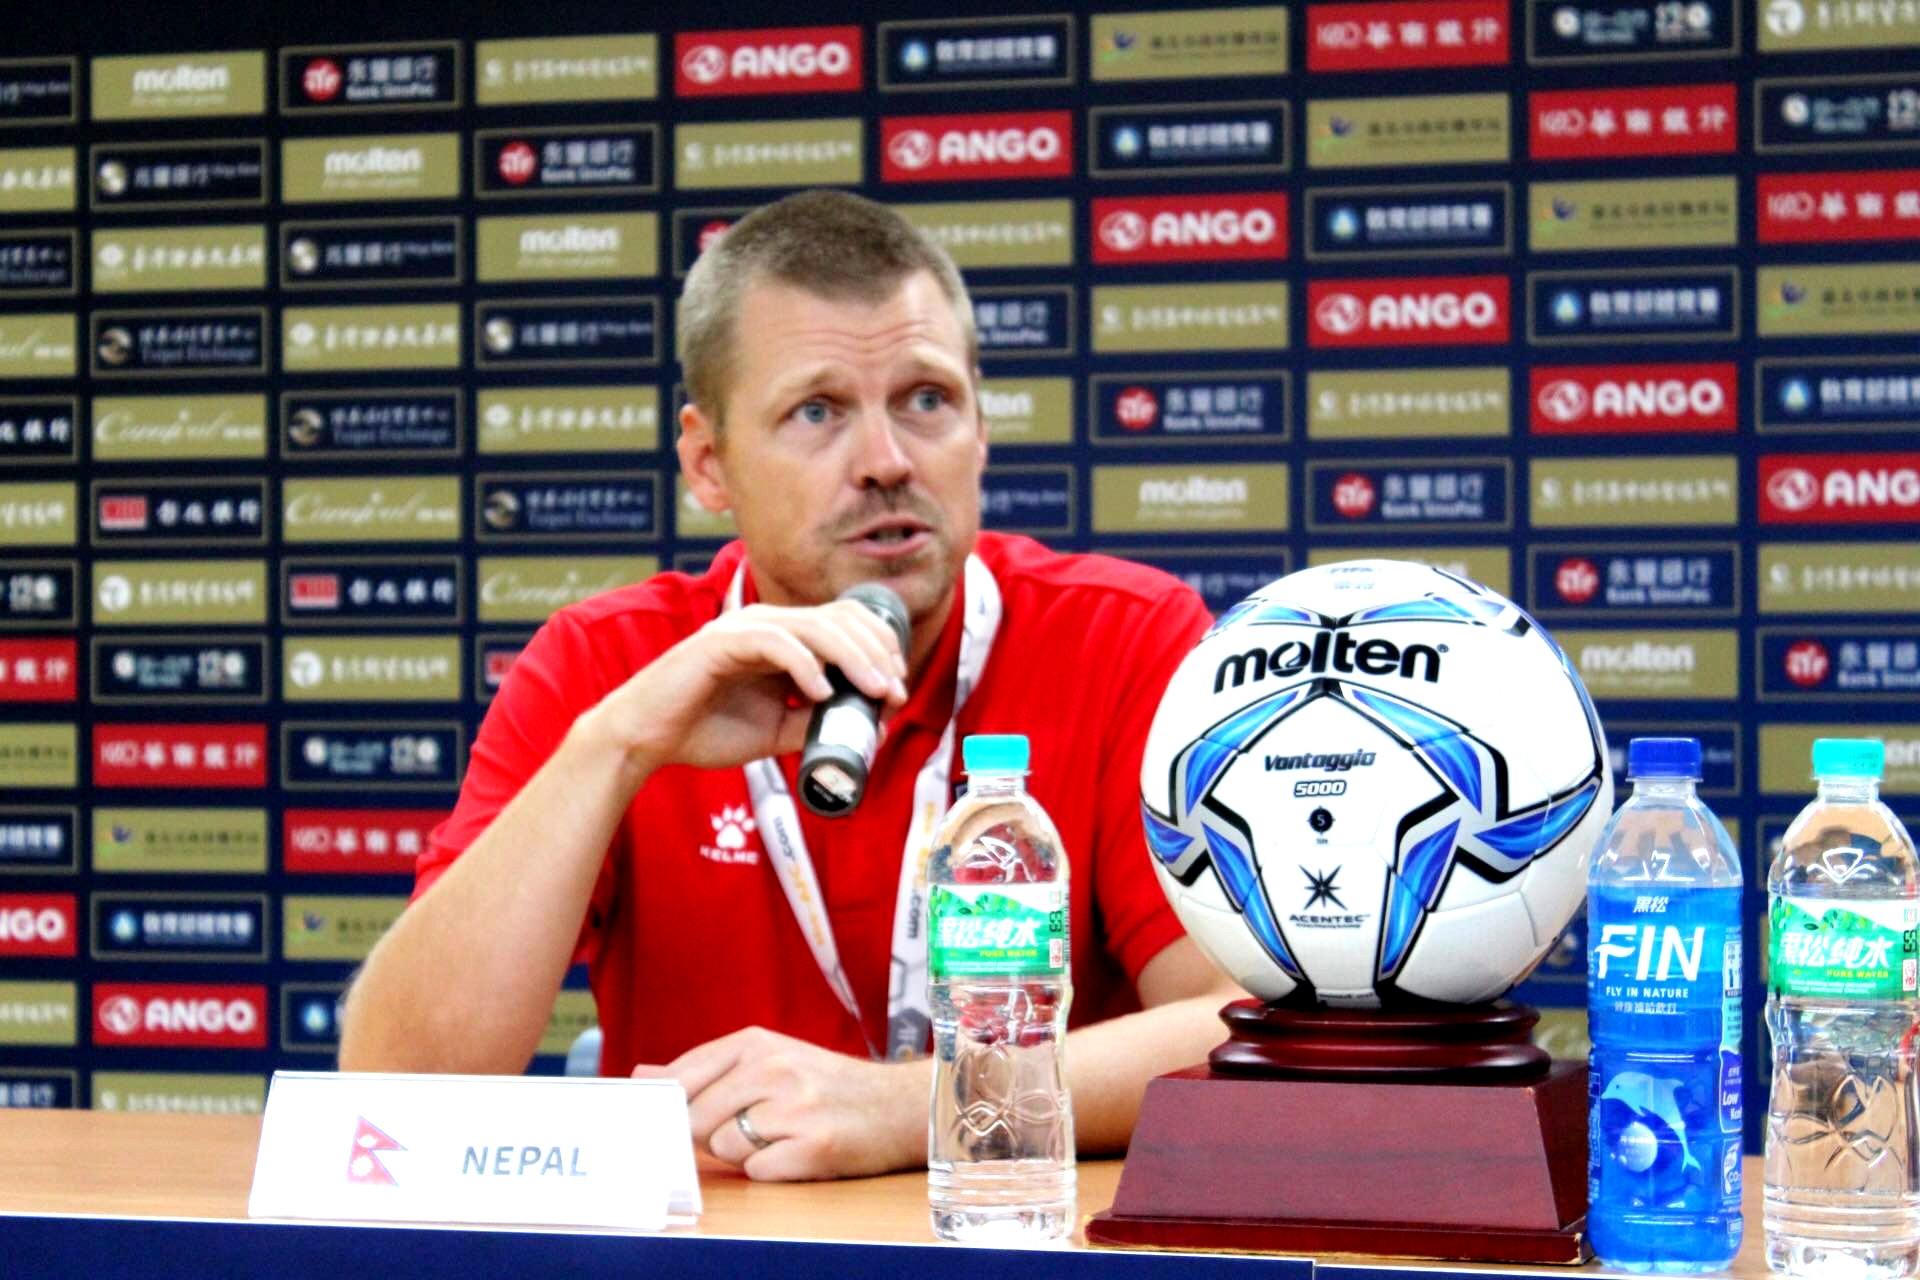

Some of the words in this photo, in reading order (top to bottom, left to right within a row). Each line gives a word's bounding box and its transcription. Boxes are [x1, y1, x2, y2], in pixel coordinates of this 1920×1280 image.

[731, 43, 850, 77] ANGO
[134, 65, 228, 91] molten
[325, 148, 422, 174] molten
[932, 128, 1060, 162] ANGO
[520, 226, 619, 252] molten
[1151, 209, 1275, 244] ANGO
[1369, 293, 1496, 328] ANGO
[1593, 380, 1723, 415] ANGO
[1140, 476, 1247, 504] molten
[1214, 630, 1441, 694] molten
[1580, 643, 1694, 674] molten
[1264, 748, 1376, 772] Vantaggio
[1294, 780, 1347, 798] 5000
[1593, 924, 1706, 982] FIN
[1606, 986, 1622, 996] FLY
[1627, 988, 1638, 997] IN
[1643, 988, 1688, 998] NATURE
[144, 999, 256, 1032] ANGO
[462, 1145, 588, 1177] NEPAL
